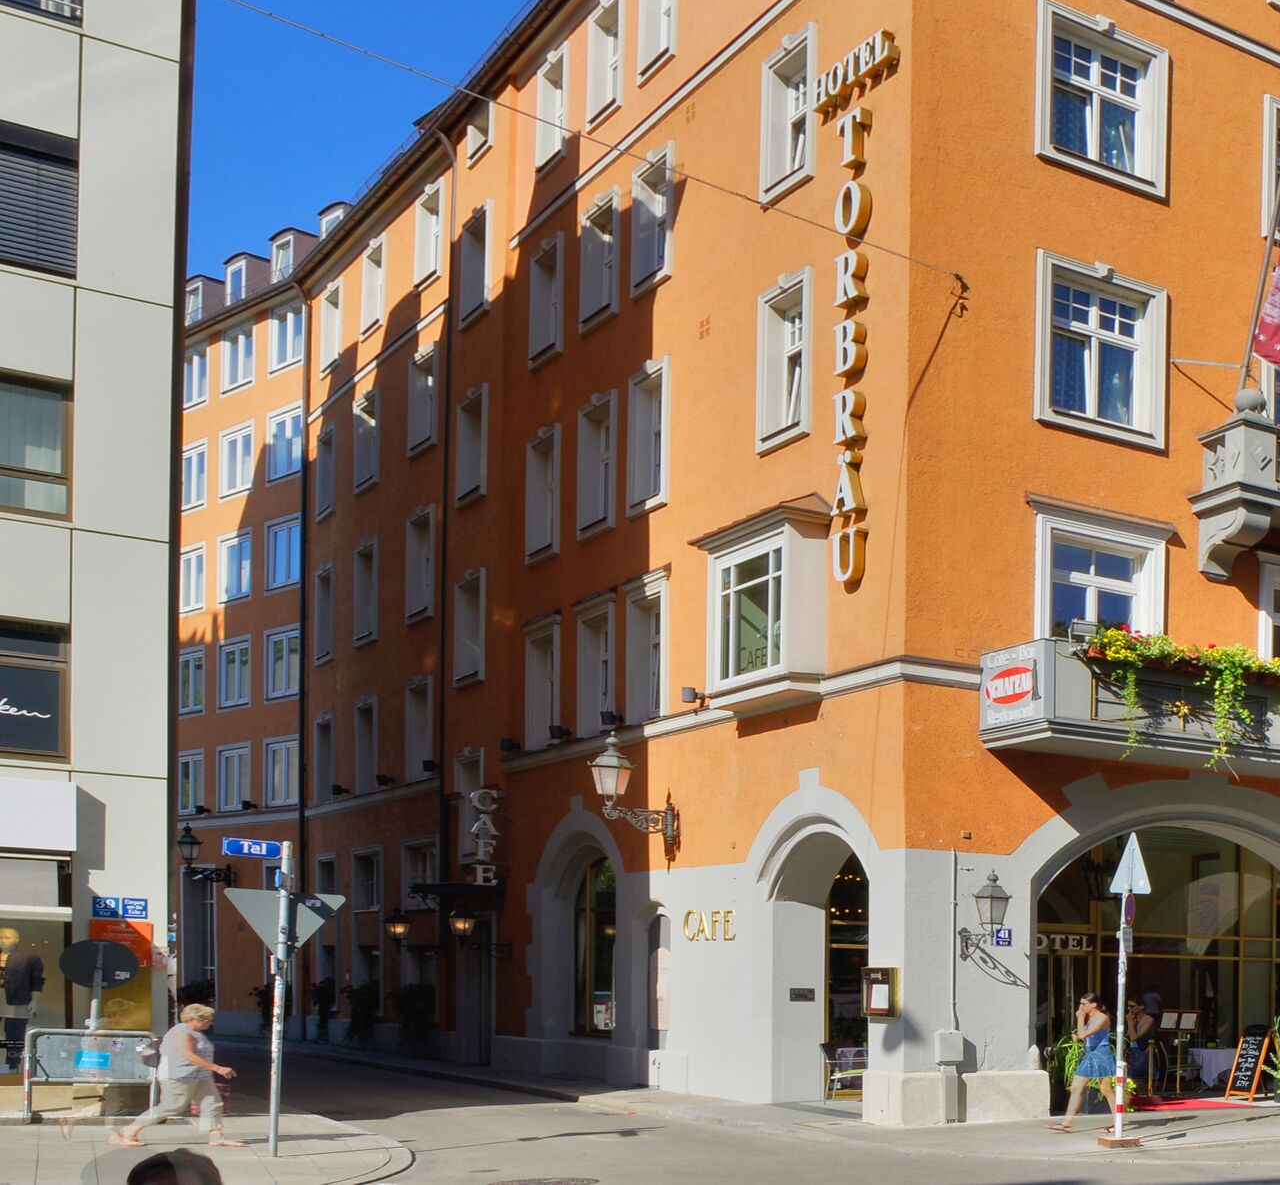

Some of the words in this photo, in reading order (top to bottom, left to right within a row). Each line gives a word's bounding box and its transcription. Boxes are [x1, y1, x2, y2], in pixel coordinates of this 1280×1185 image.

[813, 28, 897, 114] HOTEL
[831, 106, 870, 584] TORBRÄU
[240, 841, 267, 855] Tal
[470, 789, 501, 886] CAFE
[96, 898, 116, 909] 39
[683, 909, 737, 942] CAFE
[998, 930, 1009, 939] 41
[1037, 934, 1093, 951] OTEL
